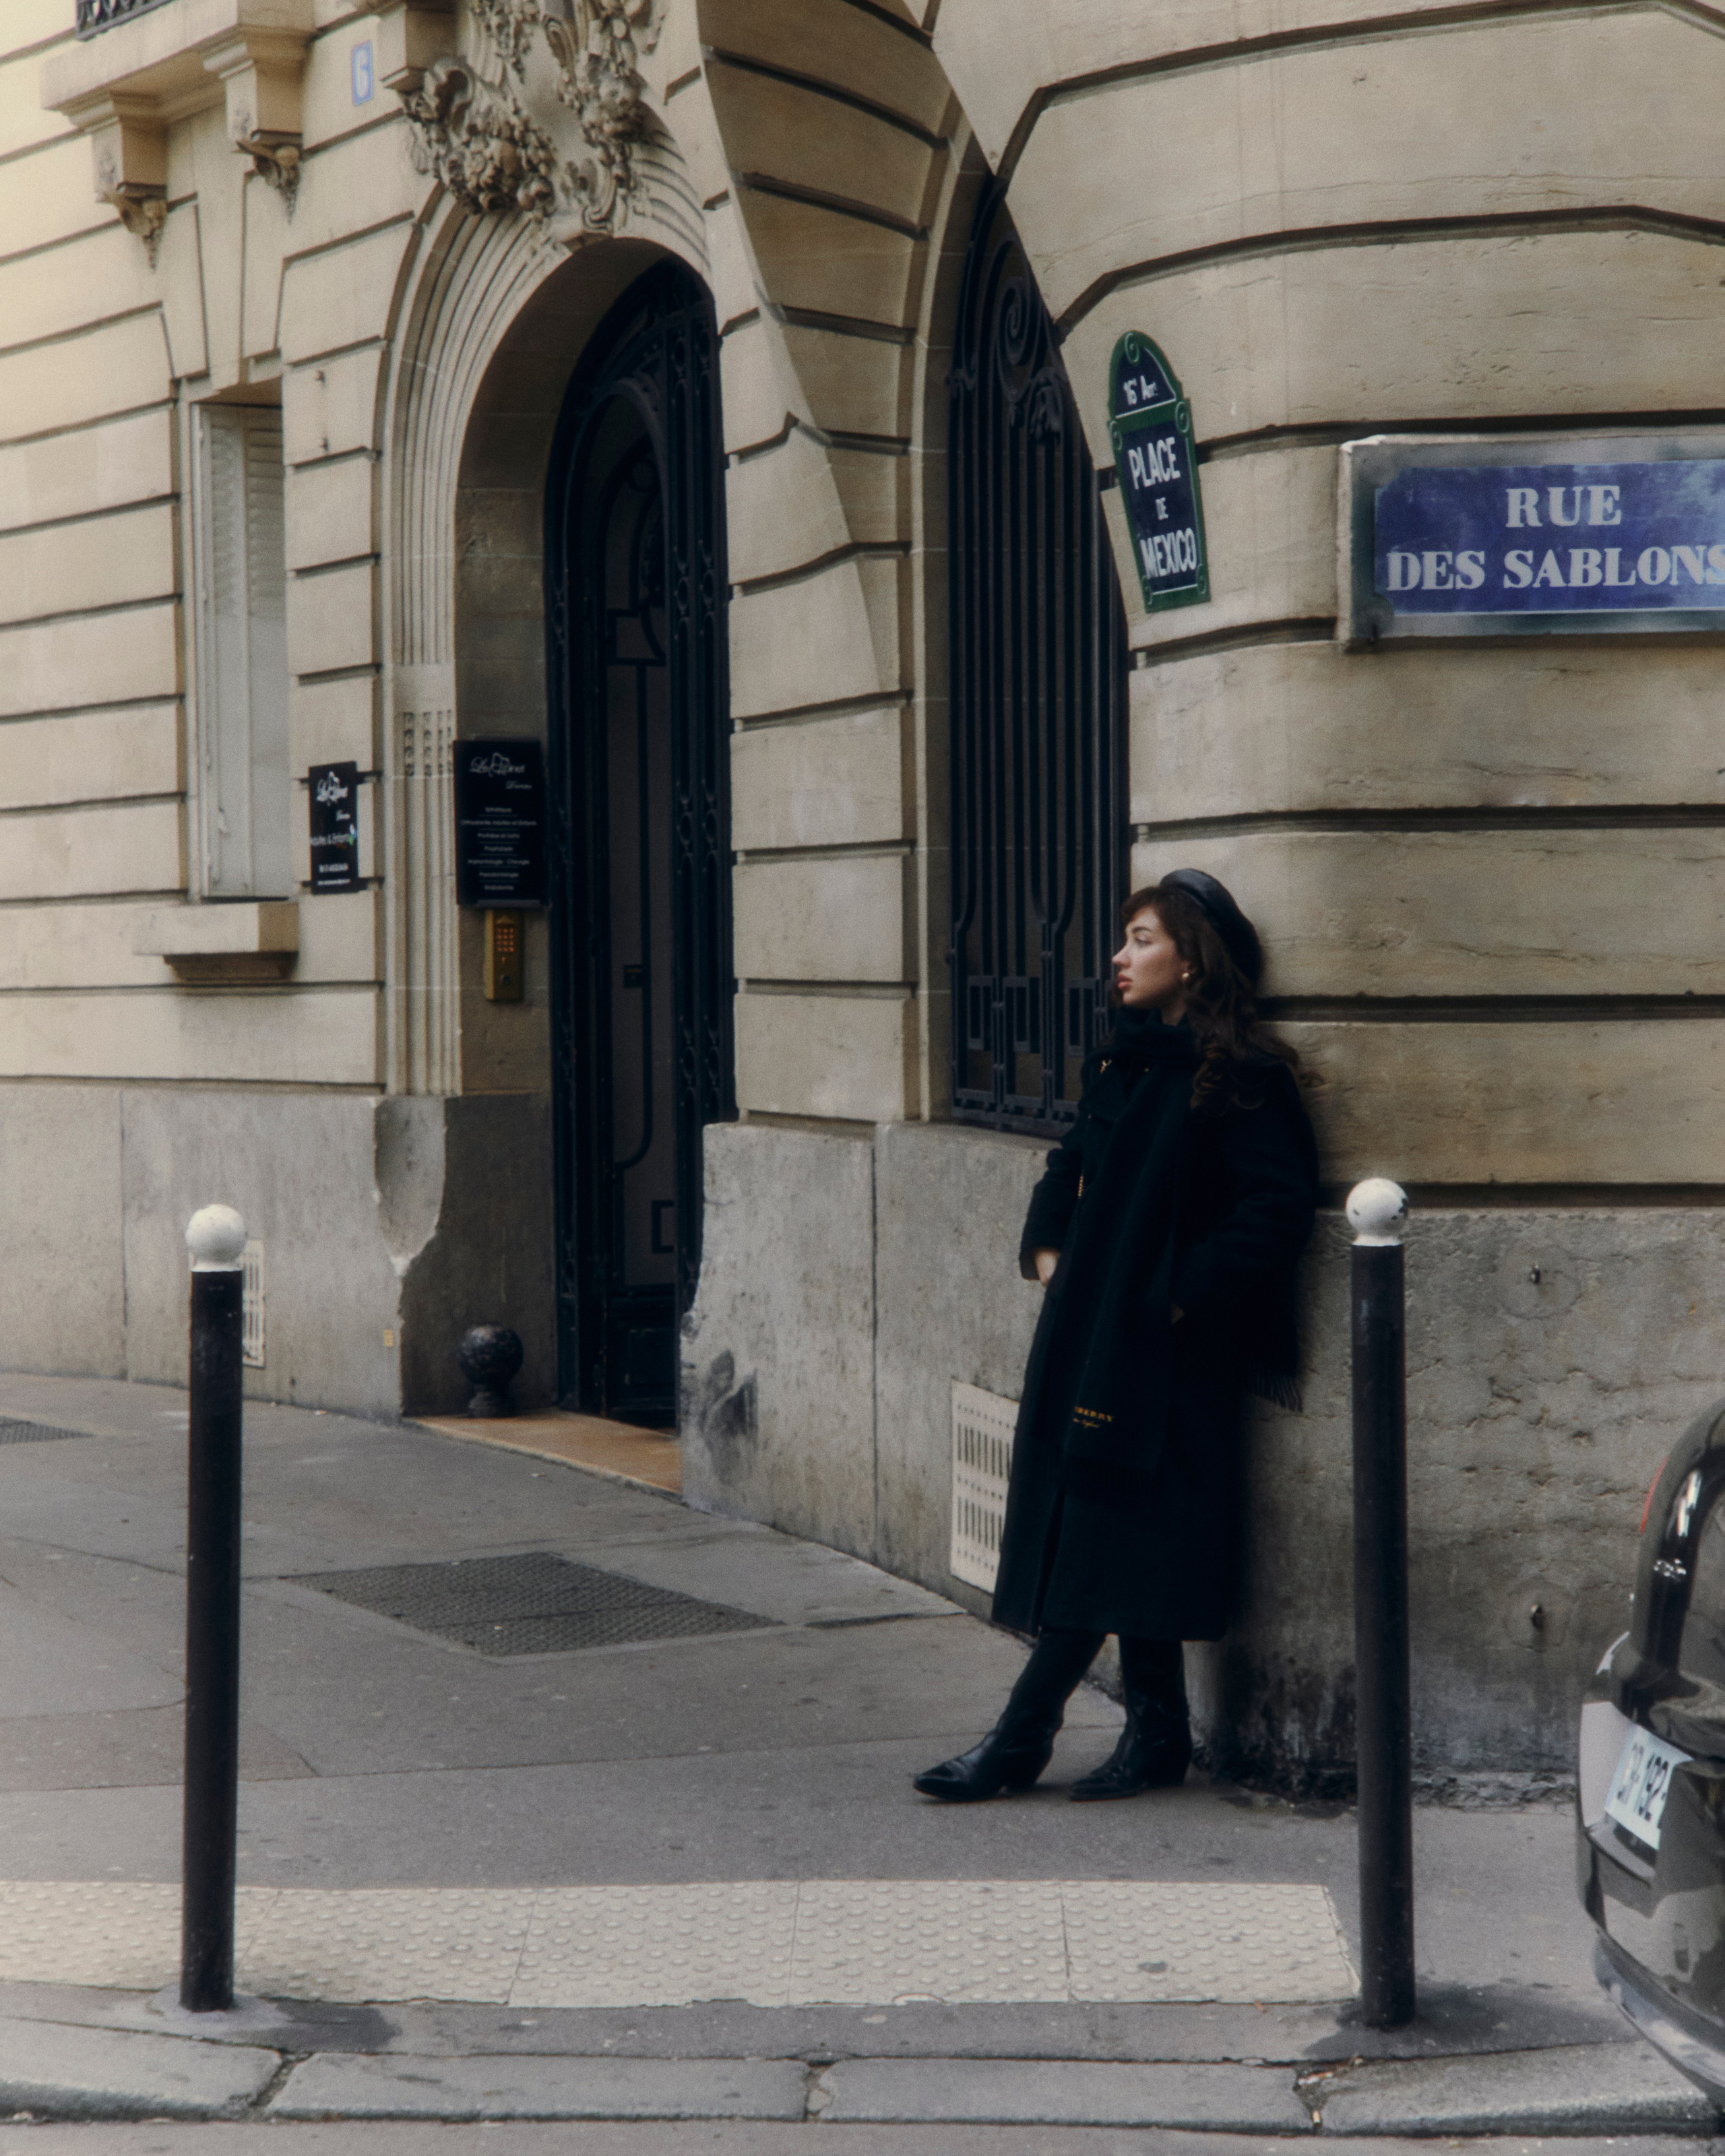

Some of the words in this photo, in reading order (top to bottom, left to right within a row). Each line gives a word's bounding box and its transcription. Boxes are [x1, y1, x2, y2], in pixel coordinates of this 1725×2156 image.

[356, 50, 368, 97] 6
[1127, 437, 1181, 490] PLACE
[1155, 497, 1169, 521] DE
[1505, 484, 1623, 528] RUE
[1140, 528, 1197, 579] MEXICO
[1385, 550, 1486, 591] DES
[1503, 544, 1725, 589] SABLONS
[1074, 1406, 1112, 1422] BERRY
